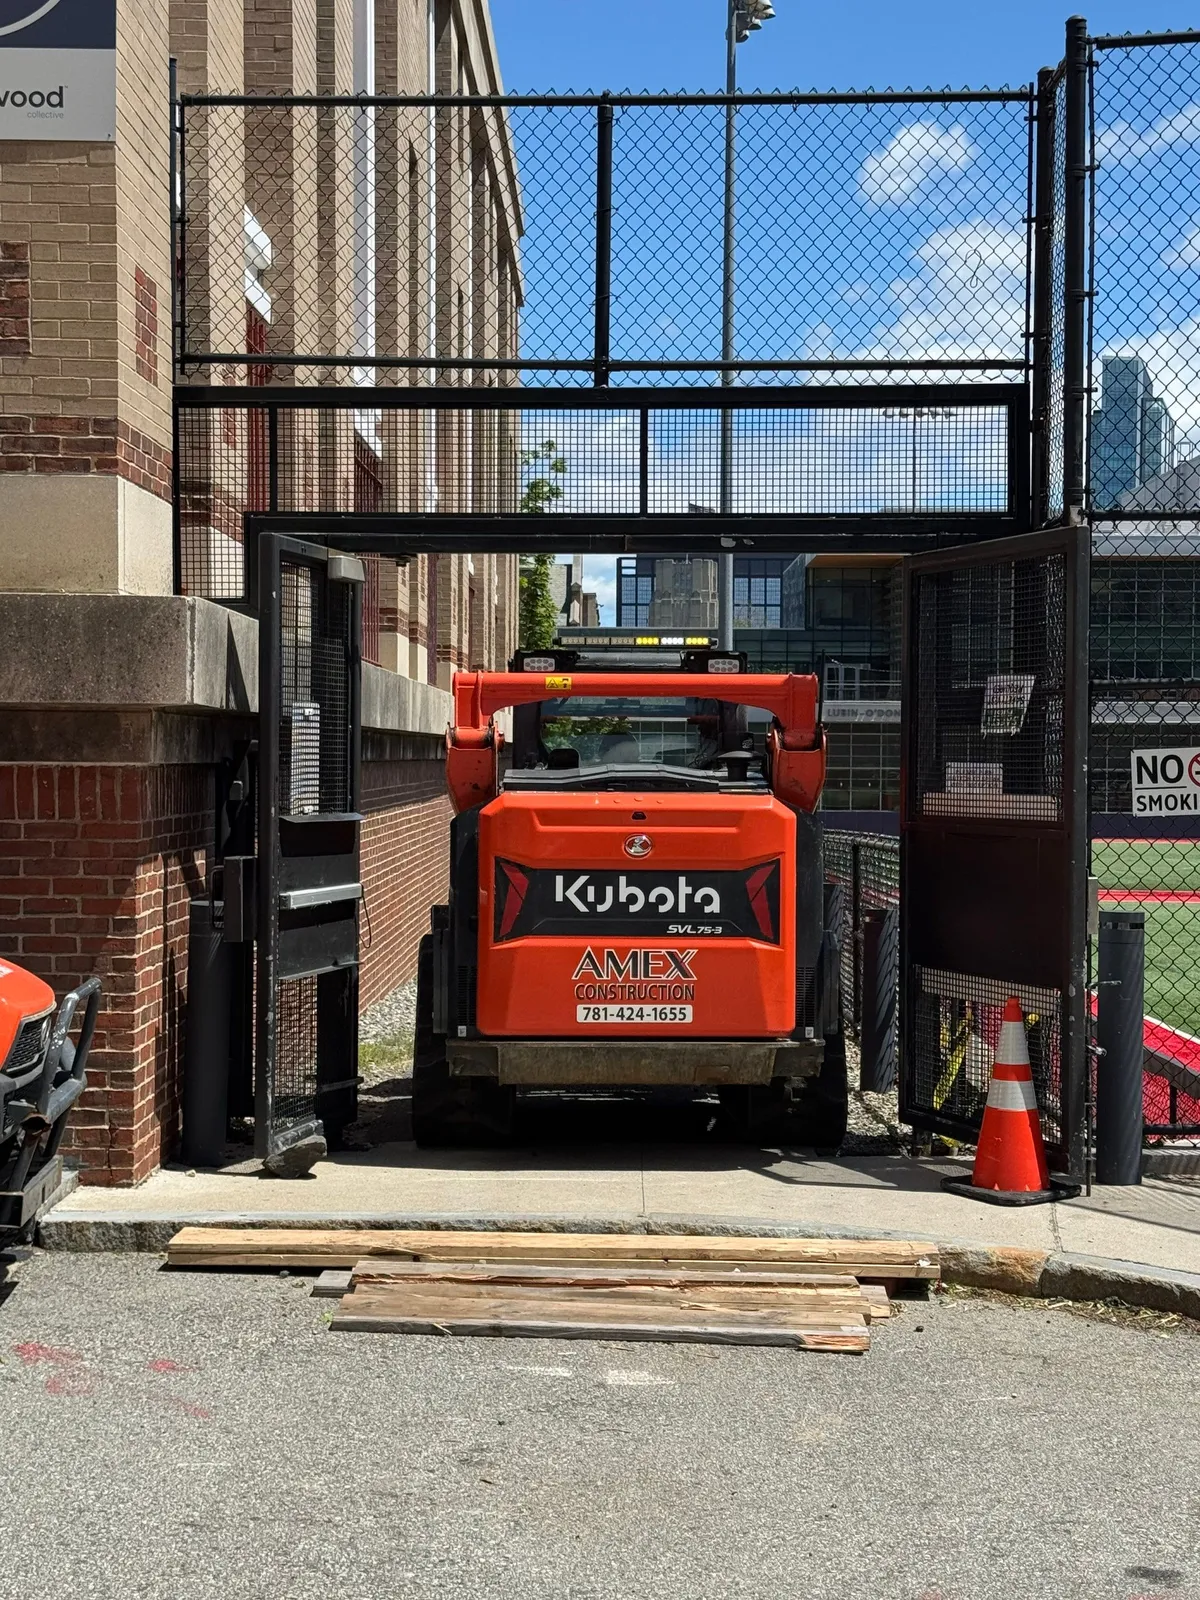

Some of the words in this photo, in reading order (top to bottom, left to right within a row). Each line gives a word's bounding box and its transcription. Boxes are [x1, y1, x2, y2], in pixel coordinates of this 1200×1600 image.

[27, 110, 64, 119] collective
[1136, 754, 1184, 784] NO
[1136, 793, 1198, 812] SMOKI
[555, 875, 720, 913] Kubota
[571, 945, 699, 982] AMEX
[574, 983, 695, 1000] CONSTRUCTION
[582, 1007, 687, 1021] 781-424-1655
